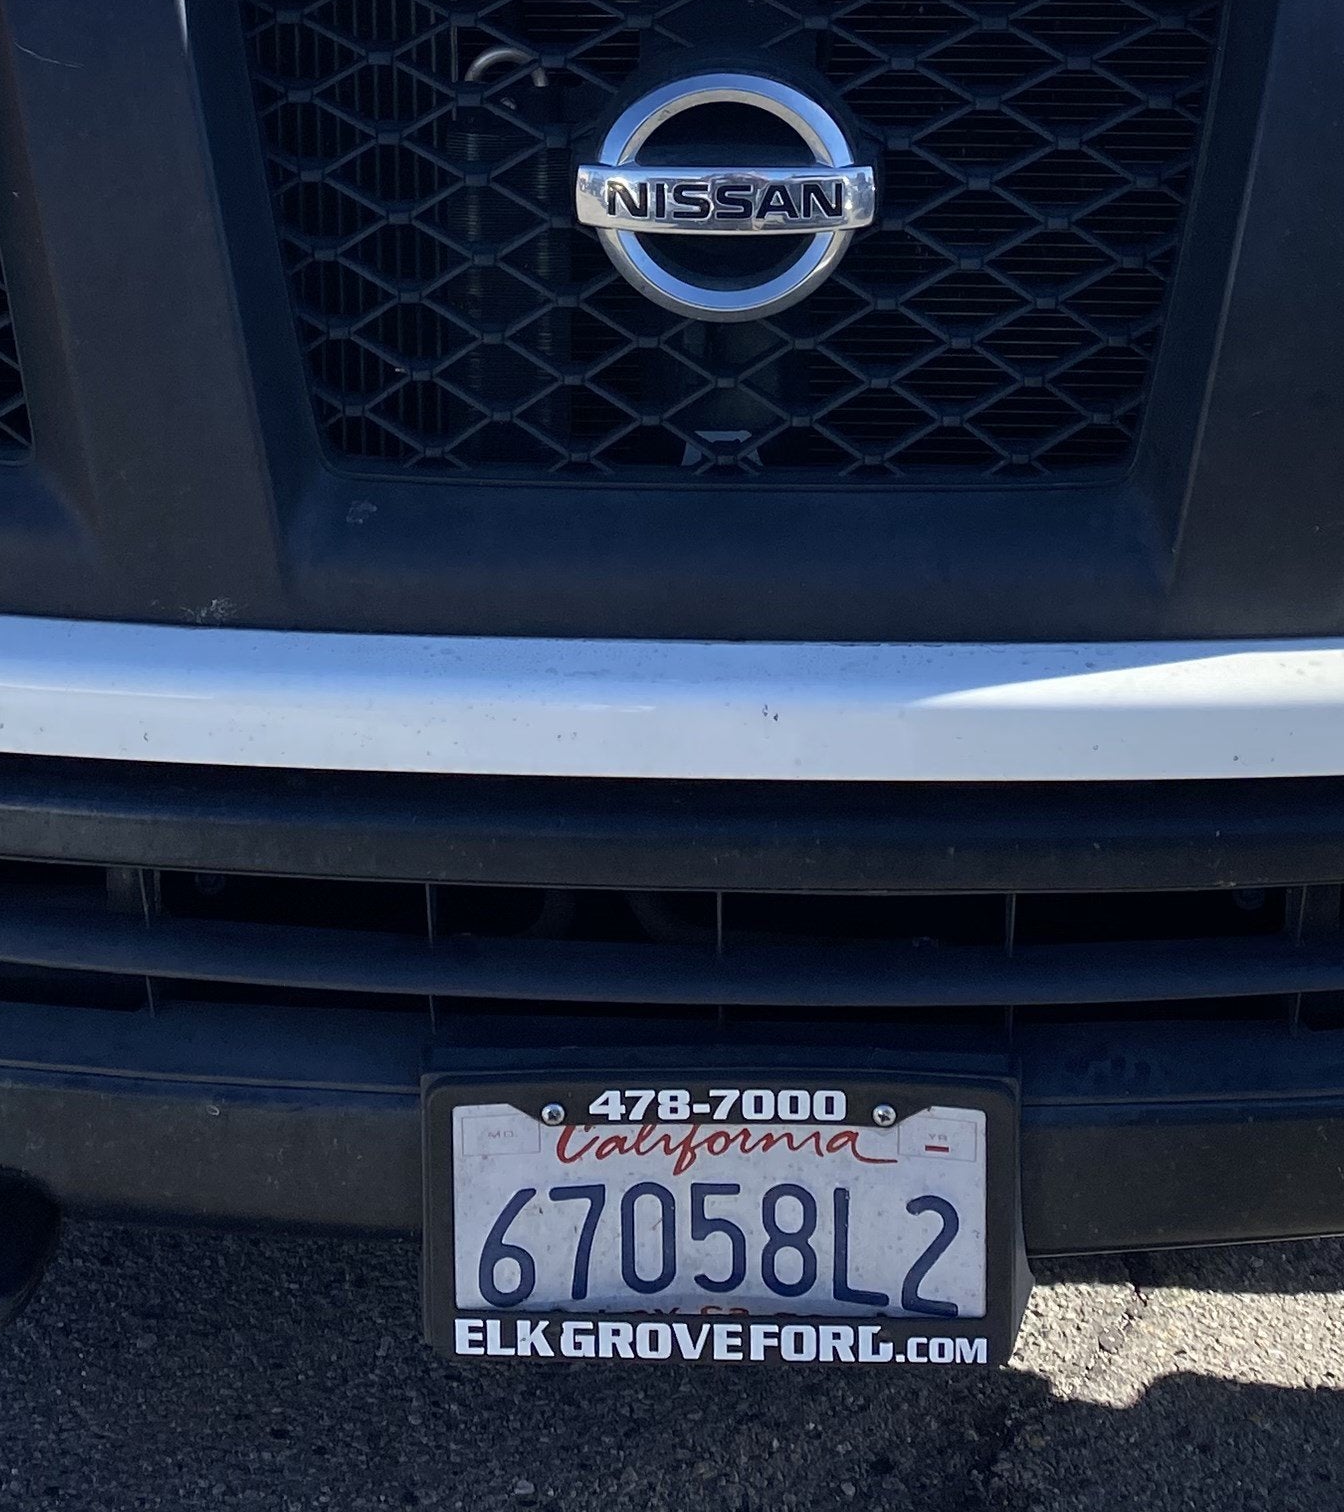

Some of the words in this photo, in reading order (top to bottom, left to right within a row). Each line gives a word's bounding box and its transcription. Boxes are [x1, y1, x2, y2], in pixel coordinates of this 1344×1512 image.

[605, 180, 845, 220] NISSAN
[588, 1088, 847, 1122] 478-7000
[555, 1123, 898, 1176] California
[478, 1181, 960, 1319] 67058L2
